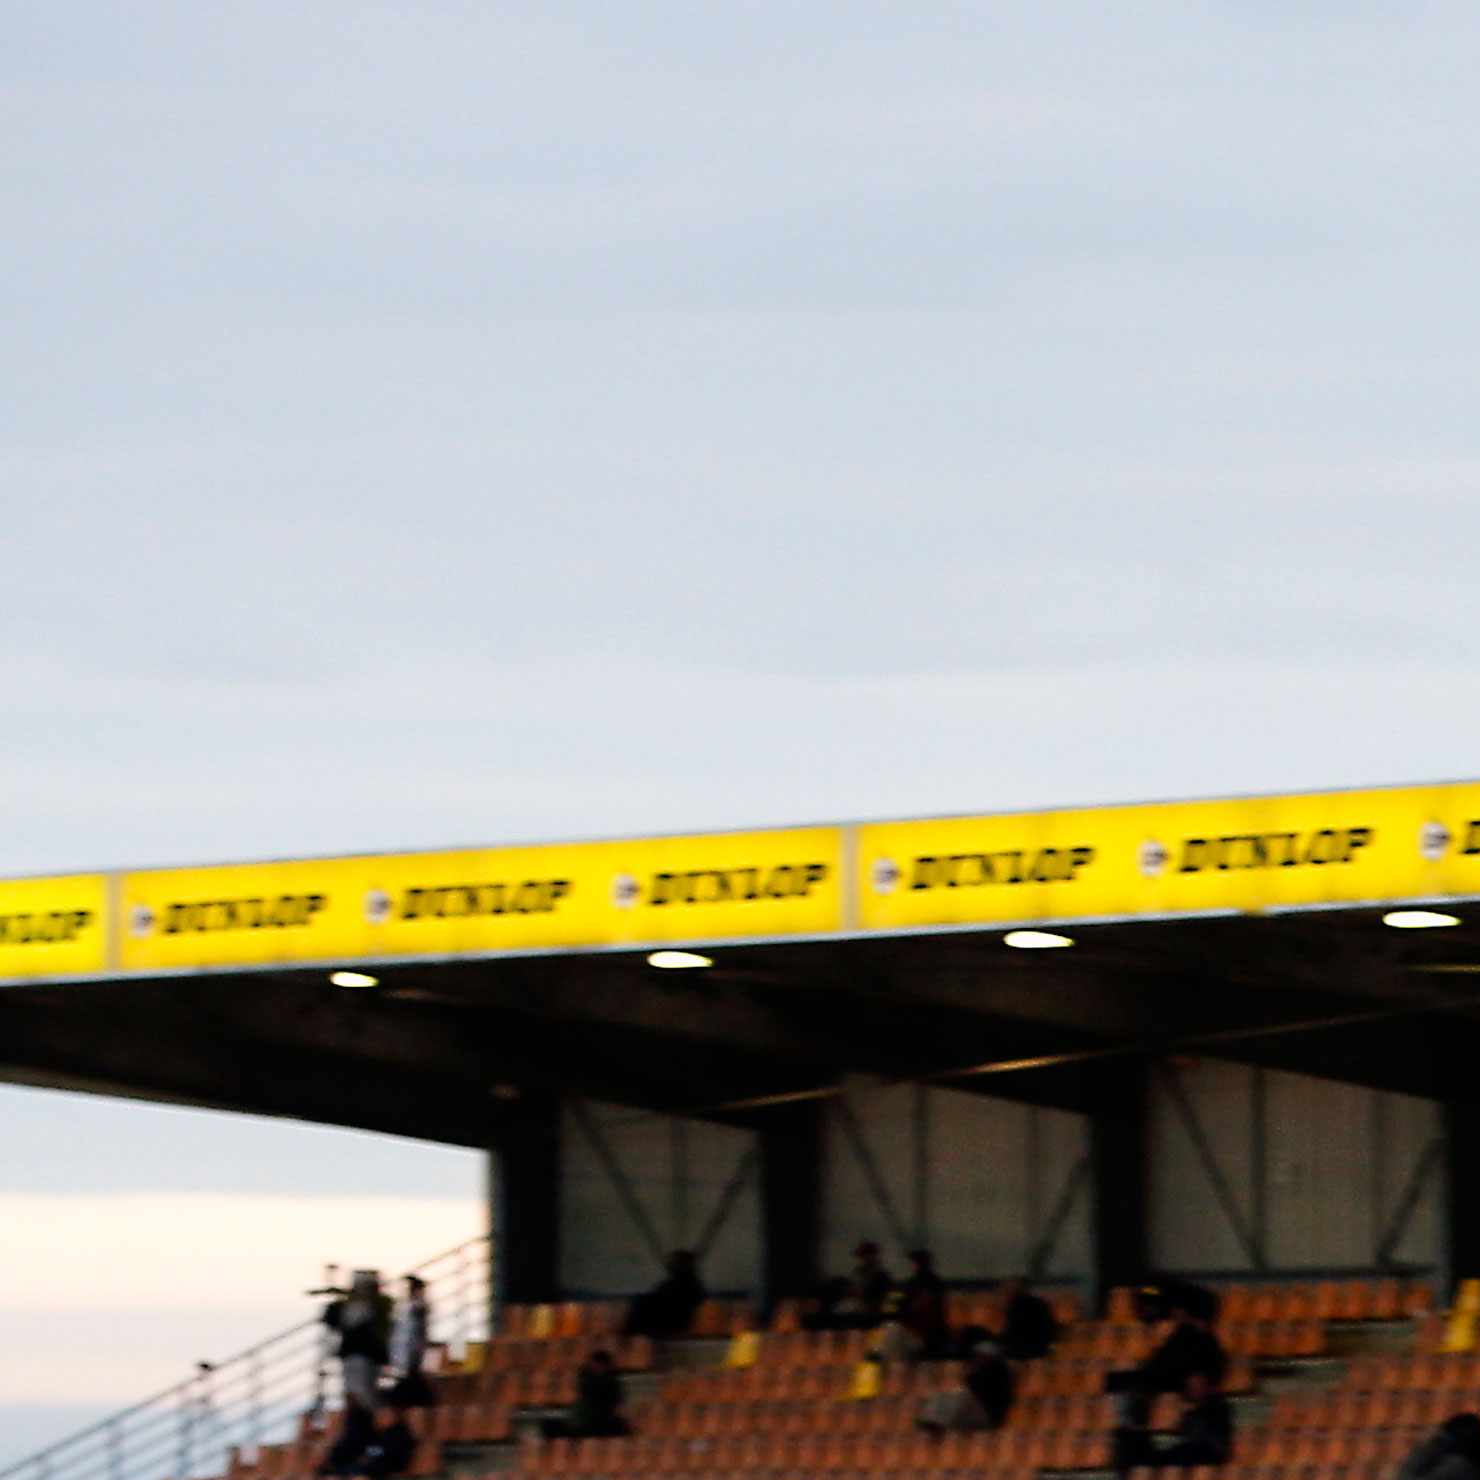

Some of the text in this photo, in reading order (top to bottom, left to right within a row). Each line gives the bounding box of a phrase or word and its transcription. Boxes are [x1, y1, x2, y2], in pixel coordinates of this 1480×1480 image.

[910, 846, 1094, 890] DUNLOP
[1178, 827, 1374, 873] DUNLOP
[401, 880, 570, 920] DUNLOP
[648, 863, 828, 906] DUNLOP
[163, 894, 327, 934] DUNLOP
